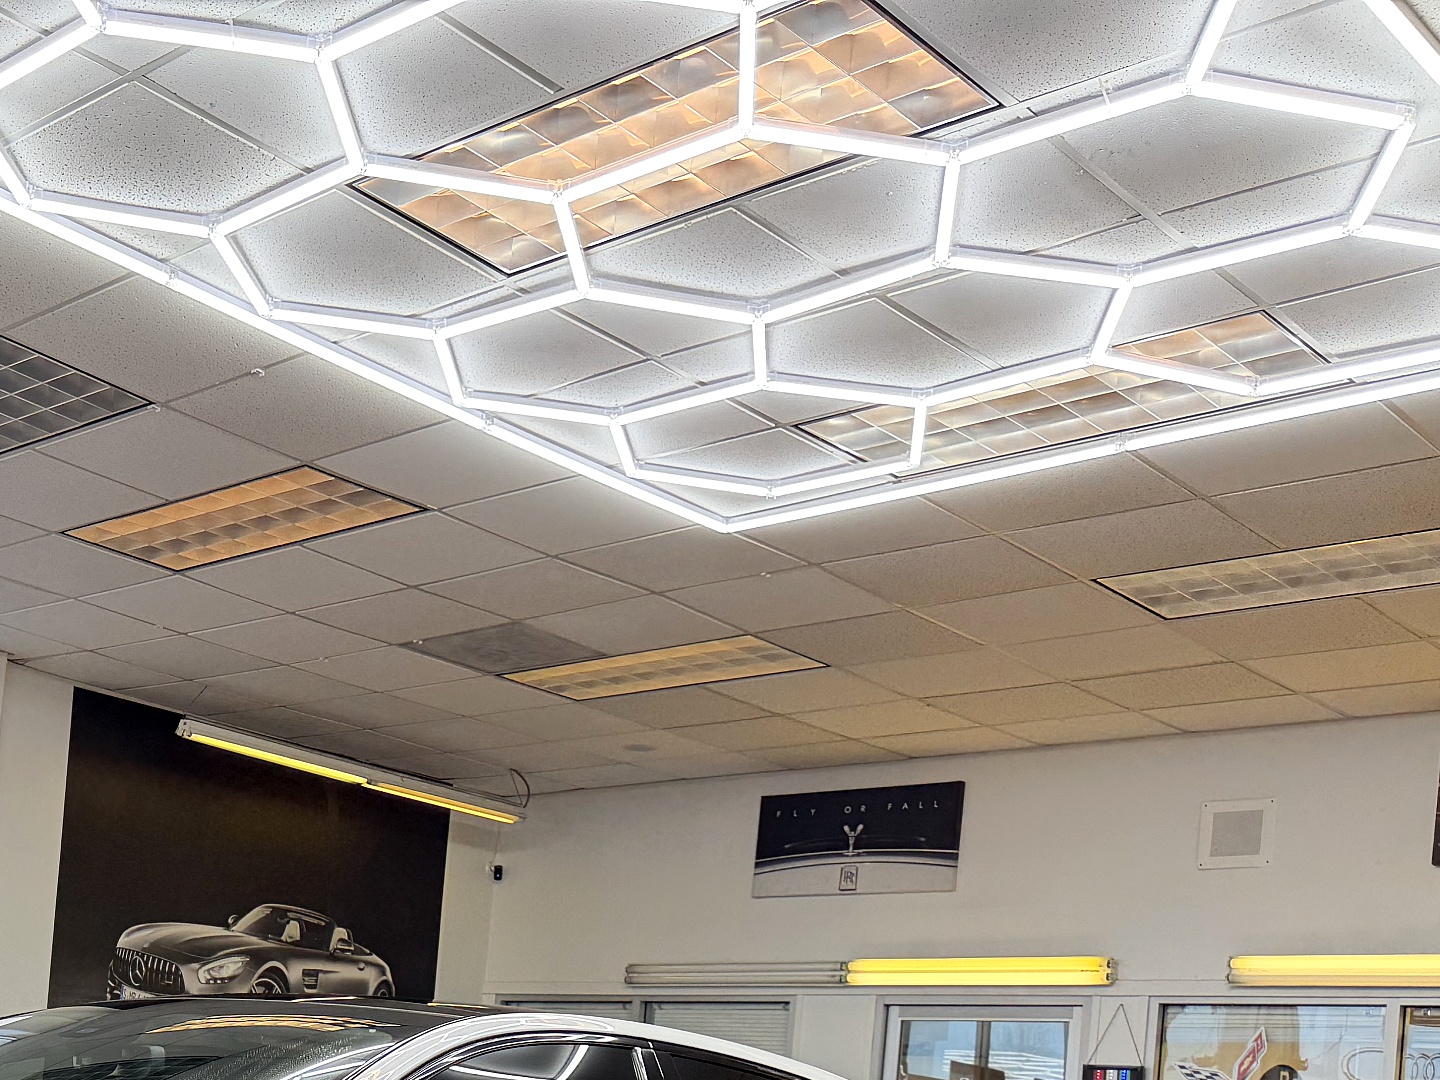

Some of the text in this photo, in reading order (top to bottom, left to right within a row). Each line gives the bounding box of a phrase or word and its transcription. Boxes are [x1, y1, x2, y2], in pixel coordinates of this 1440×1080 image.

[775, 800, 939, 818] FLY OR FALL
